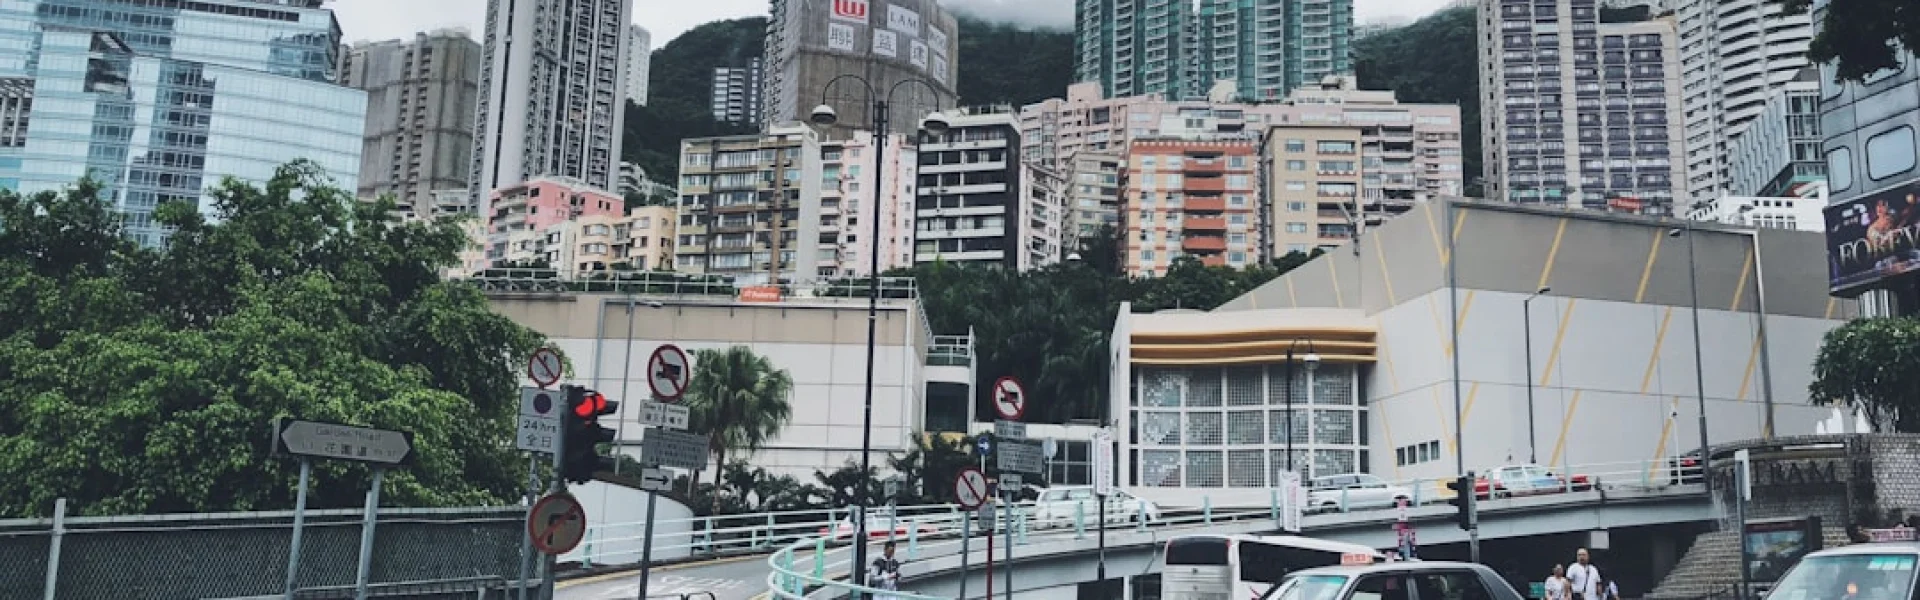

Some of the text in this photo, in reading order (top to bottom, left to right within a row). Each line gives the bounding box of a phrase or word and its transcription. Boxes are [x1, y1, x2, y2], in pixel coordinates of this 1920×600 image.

[891, 11, 917, 29] LAM
[523, 420, 557, 433] 24 hrs
[525, 433, 552, 448] 全日
